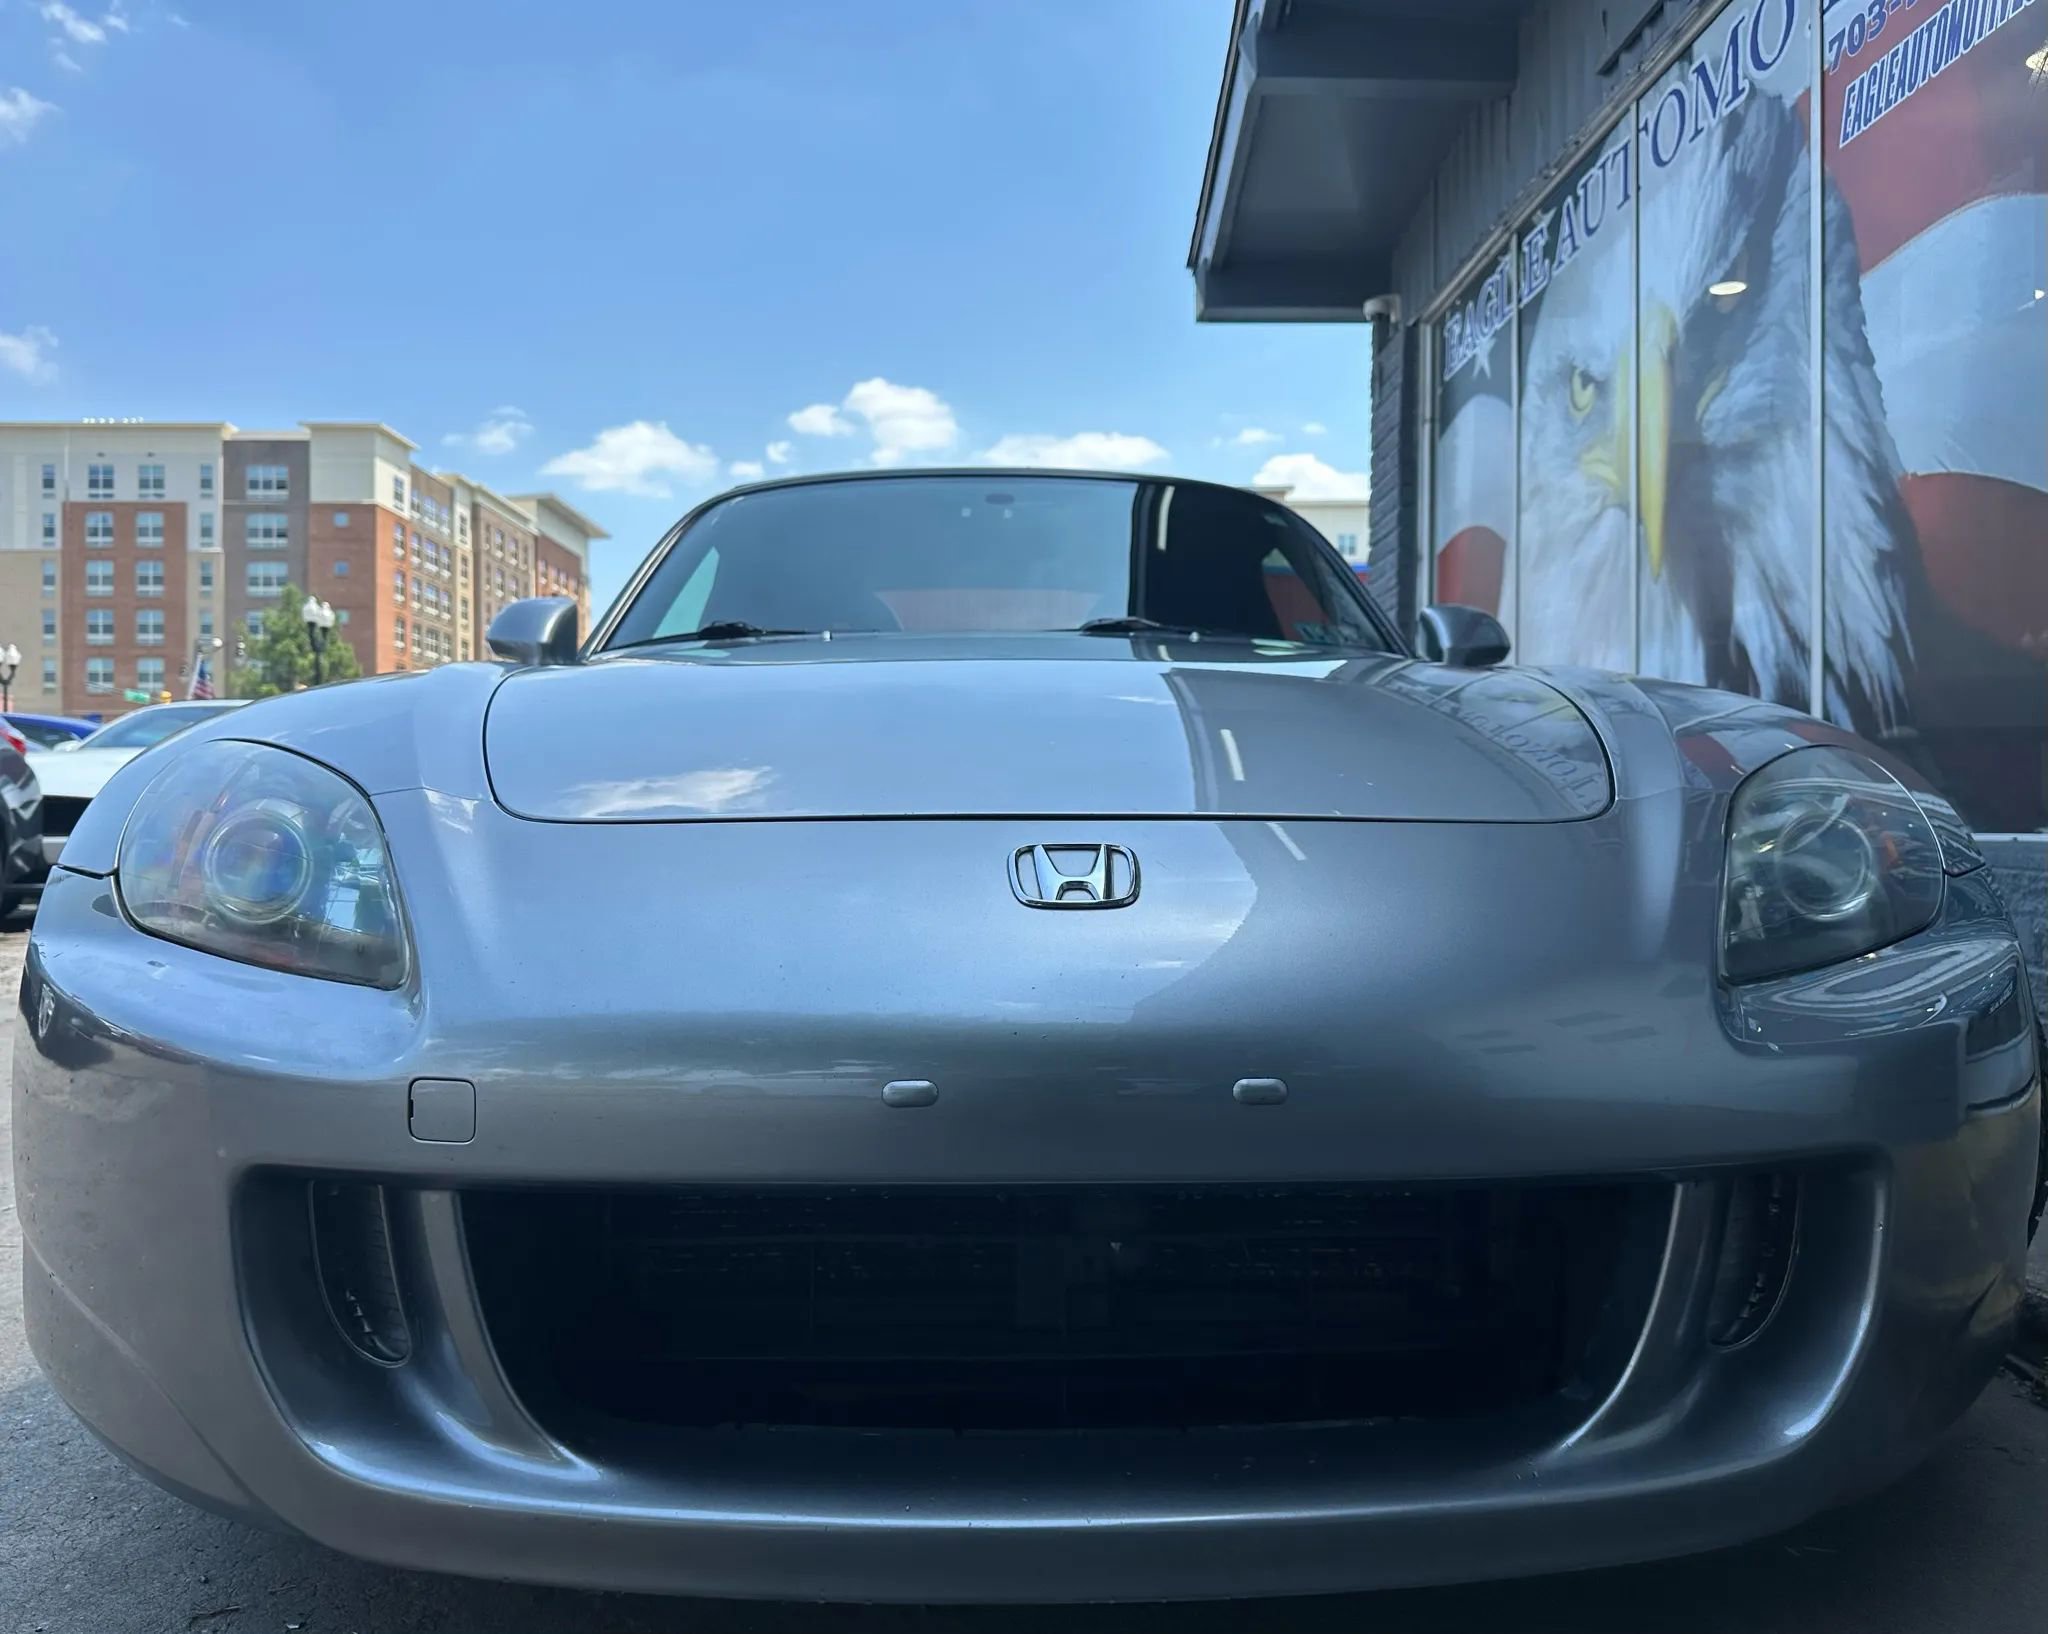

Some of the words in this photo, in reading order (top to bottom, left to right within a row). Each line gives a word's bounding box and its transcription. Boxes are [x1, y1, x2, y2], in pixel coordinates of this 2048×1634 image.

[1828, 0, 1919, 76] 703-
[1443, 224, 1550, 382] EAGLE
[1552, 0, 1811, 277] AUTOMO
